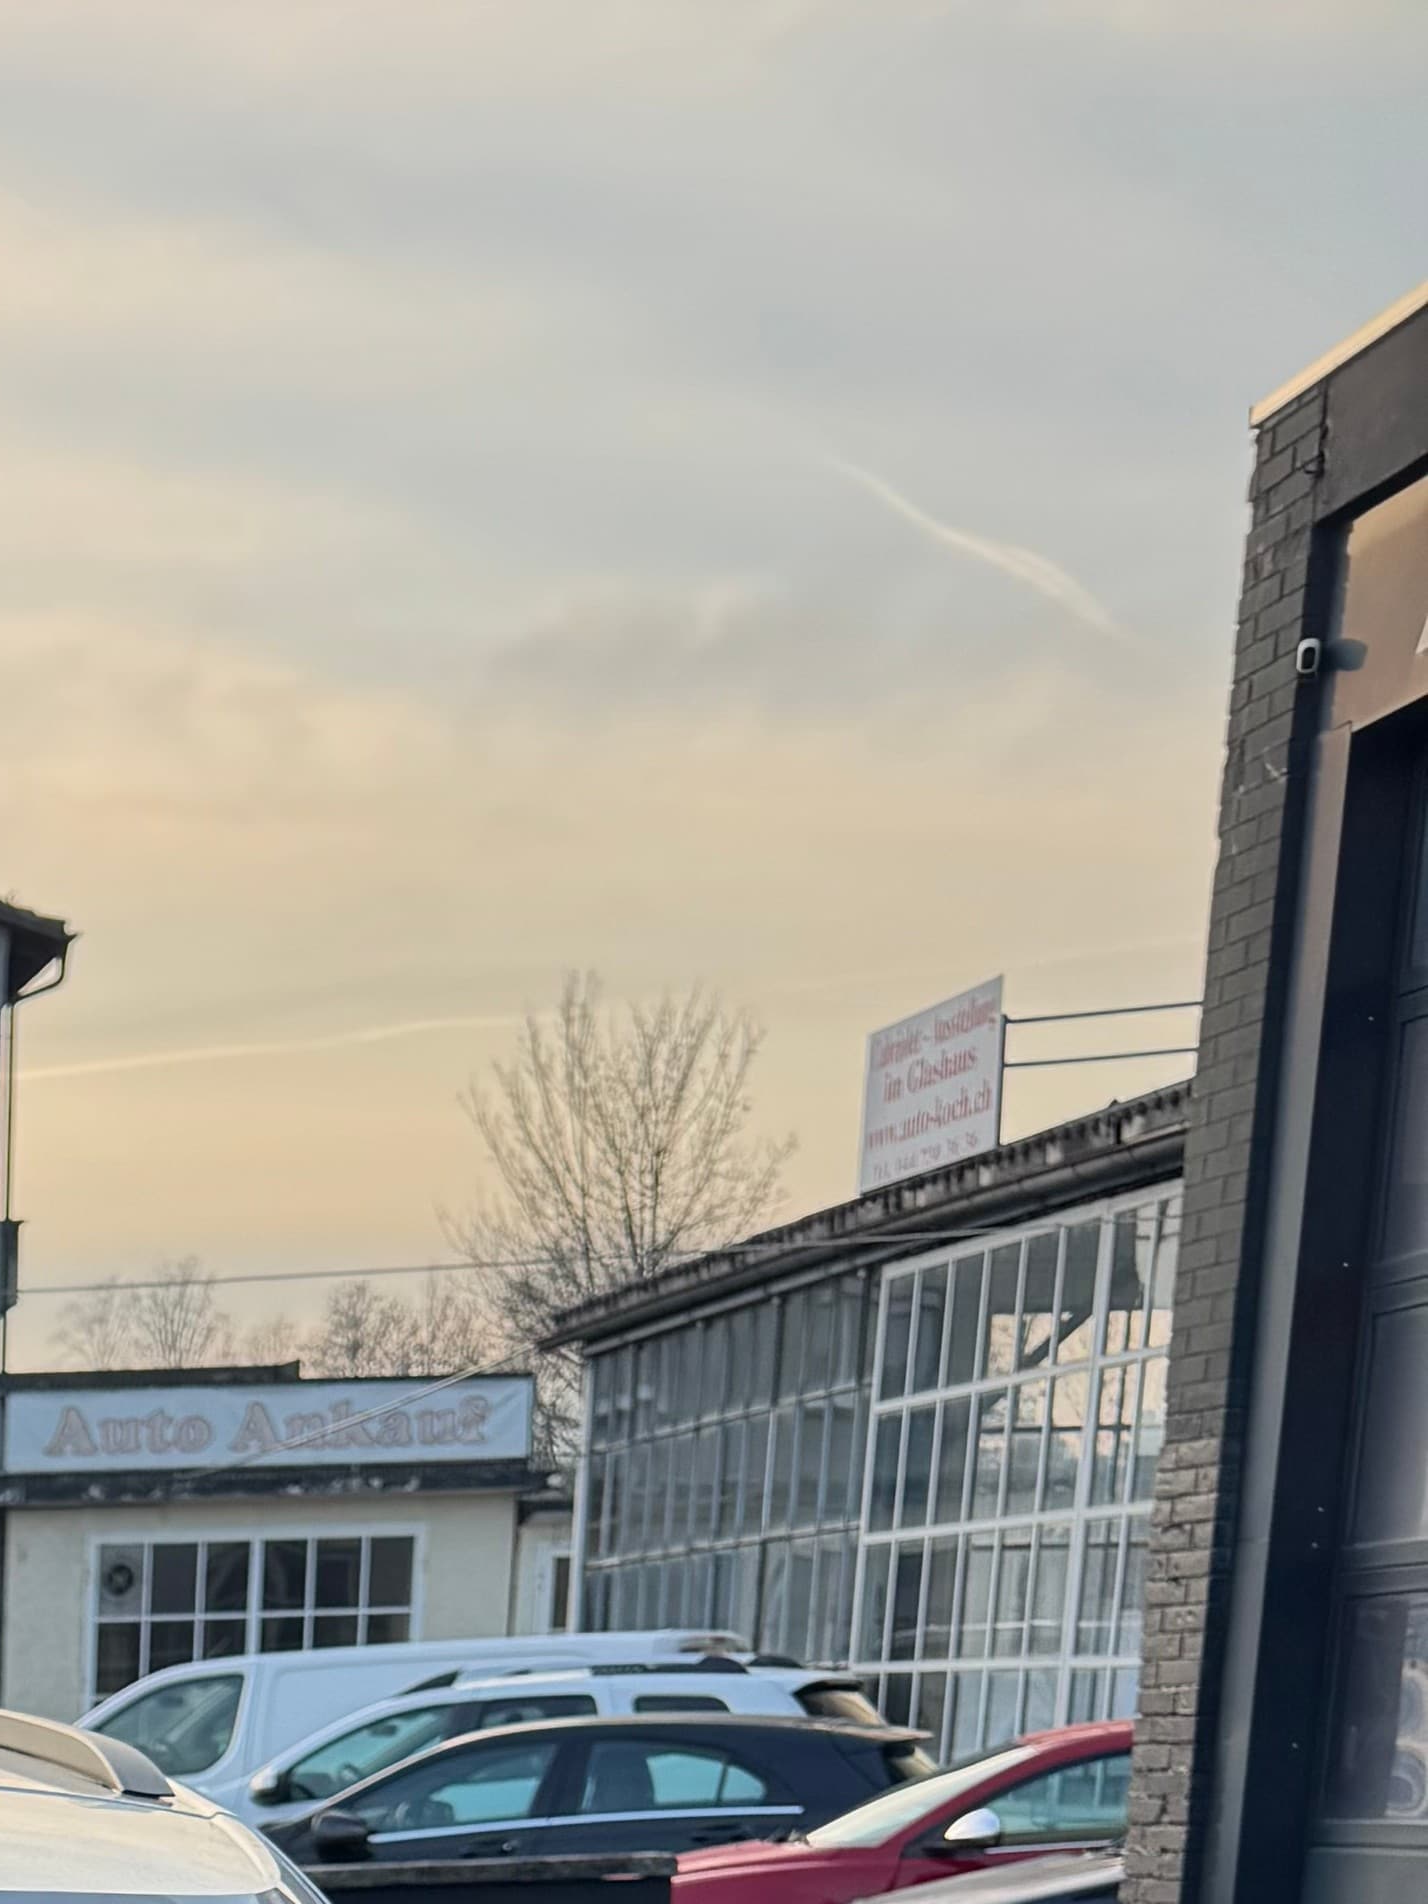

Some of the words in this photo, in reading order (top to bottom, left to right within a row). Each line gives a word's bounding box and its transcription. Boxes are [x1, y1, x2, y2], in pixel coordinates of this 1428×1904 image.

[906, 1046, 978, 1093] Glashaus
[43, 1405, 213, 1457] Auto
[228, 1395, 493, 1453] Ankauf
